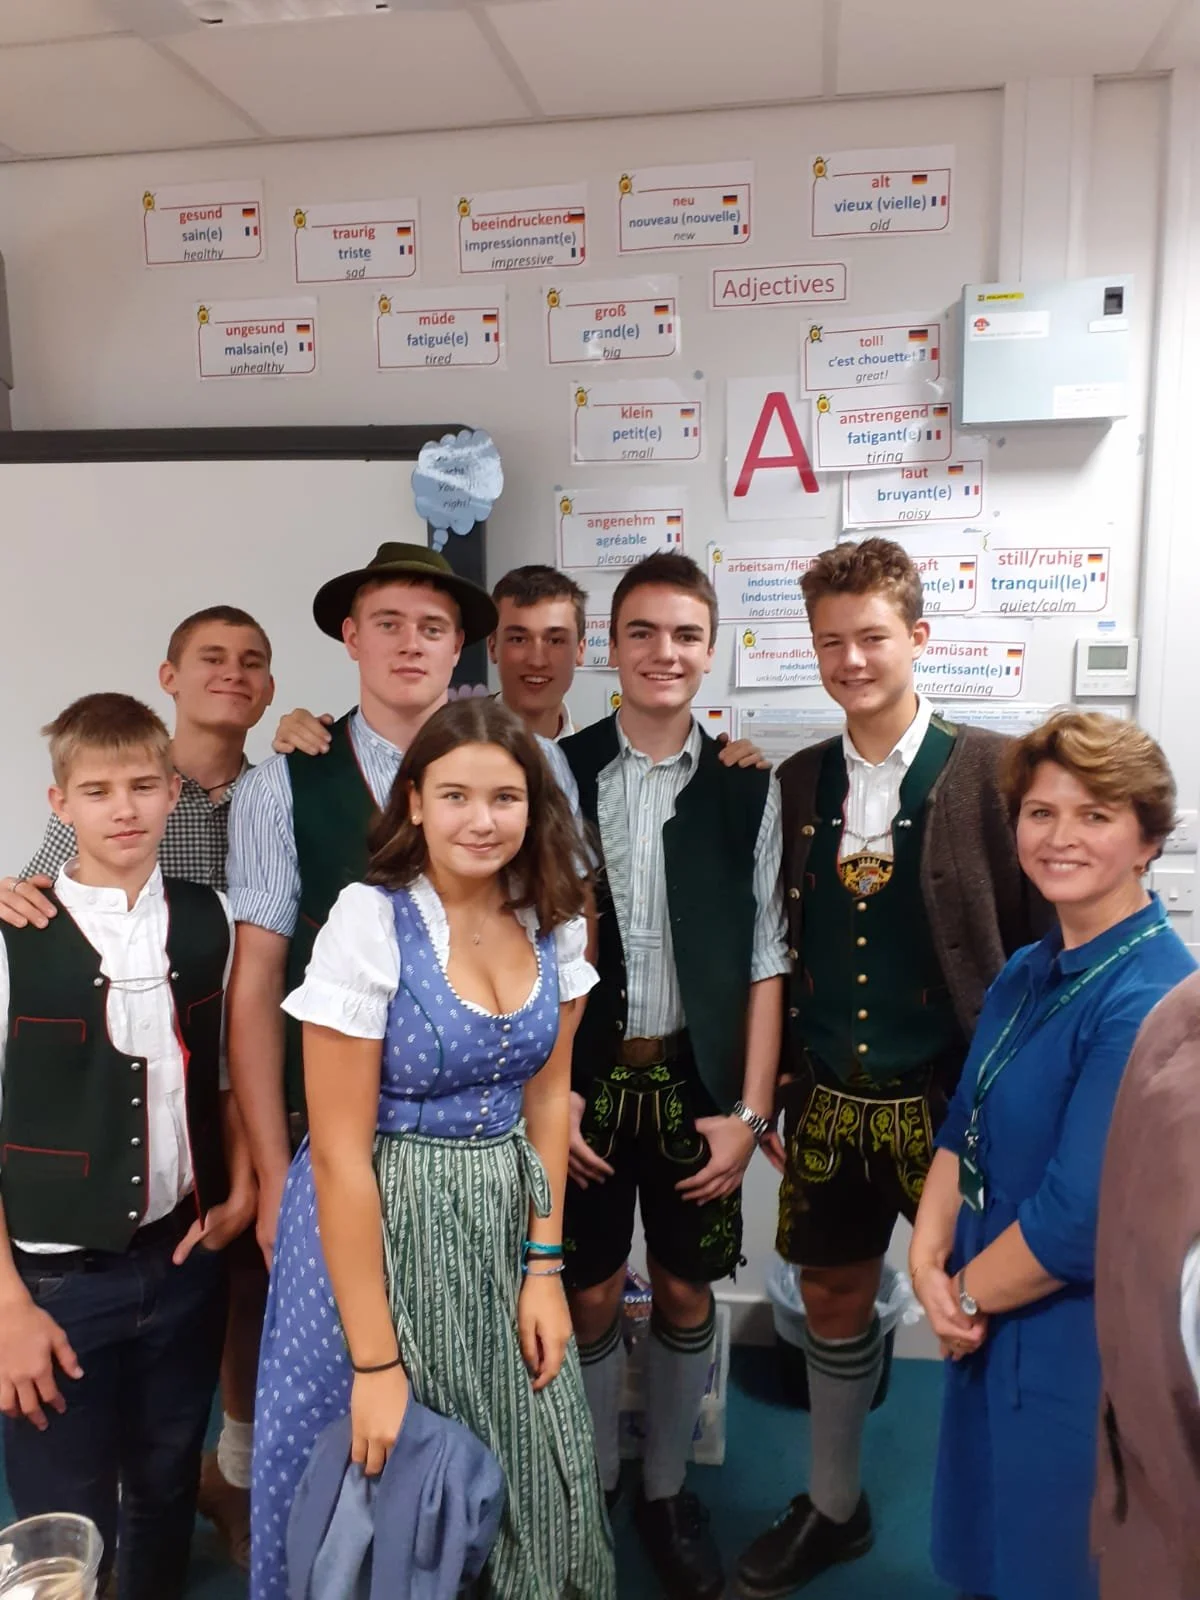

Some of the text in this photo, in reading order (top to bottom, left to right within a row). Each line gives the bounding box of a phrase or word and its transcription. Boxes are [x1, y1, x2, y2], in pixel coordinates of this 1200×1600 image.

[871, 175, 890, 188] alt
[672, 196, 695, 207] neu
[834, 195, 926, 213] vieux (vielle)
[179, 208, 222, 224] gesund
[471, 211, 571, 232] beeindruckend
[629, 210, 741, 228] nouveau (nouvelle)
[869, 218, 890, 232] old
[182, 228, 223, 243] sain(e)
[332, 226, 376, 242] traurig
[673, 231, 696, 242] new
[464, 231, 577, 253] impressionnant(e)
[183, 248, 224, 262] healthy
[338, 247, 371, 261] triste
[491, 253, 554, 270] impressive
[345, 266, 366, 279] sad
[722, 273, 835, 303] Adjectives
[419, 312, 455, 325] müde
[594, 304, 626, 321] groß
[225, 322, 285, 337] ungesund
[583, 324, 640, 343] grand(e)
[407, 331, 469, 348] fatigué(e)
[859, 335, 884, 348] toll!
[224, 342, 288, 357] malsain(e)
[602, 346, 621, 360] big
[425, 353, 452, 365] tired
[828, 355, 855, 367] c'est
[230, 361, 285, 375] unhealthy
[855, 370, 889, 383] great!
[621, 406, 653, 419] klein
[839, 405, 929, 425] anstrengend
[612, 426, 662, 442] petit(e)
[847, 425, 922, 445] fatigant(e)
[734, 391, 820, 497] A
[621, 447, 654, 459] small
[866, 449, 904, 464] tiring
[901, 467, 928, 479] laut
[877, 485, 952, 502] bruyant(e)
[587, 514, 655, 530] angenehm
[898, 509, 931, 521] noisy
[596, 533, 647, 548] agréable
[997, 550, 1083, 568] still/ruhig
[747, 577, 801, 587] industrieu
[991, 574, 1088, 593] tranquil(le)
[741, 589, 803, 604] (industrieus
[749, 606, 804, 617] industrious
[999, 598, 1077, 613] quiet/calm
[926, 643, 989, 657] amüsant
[916, 682, 994, 696] entertaining
